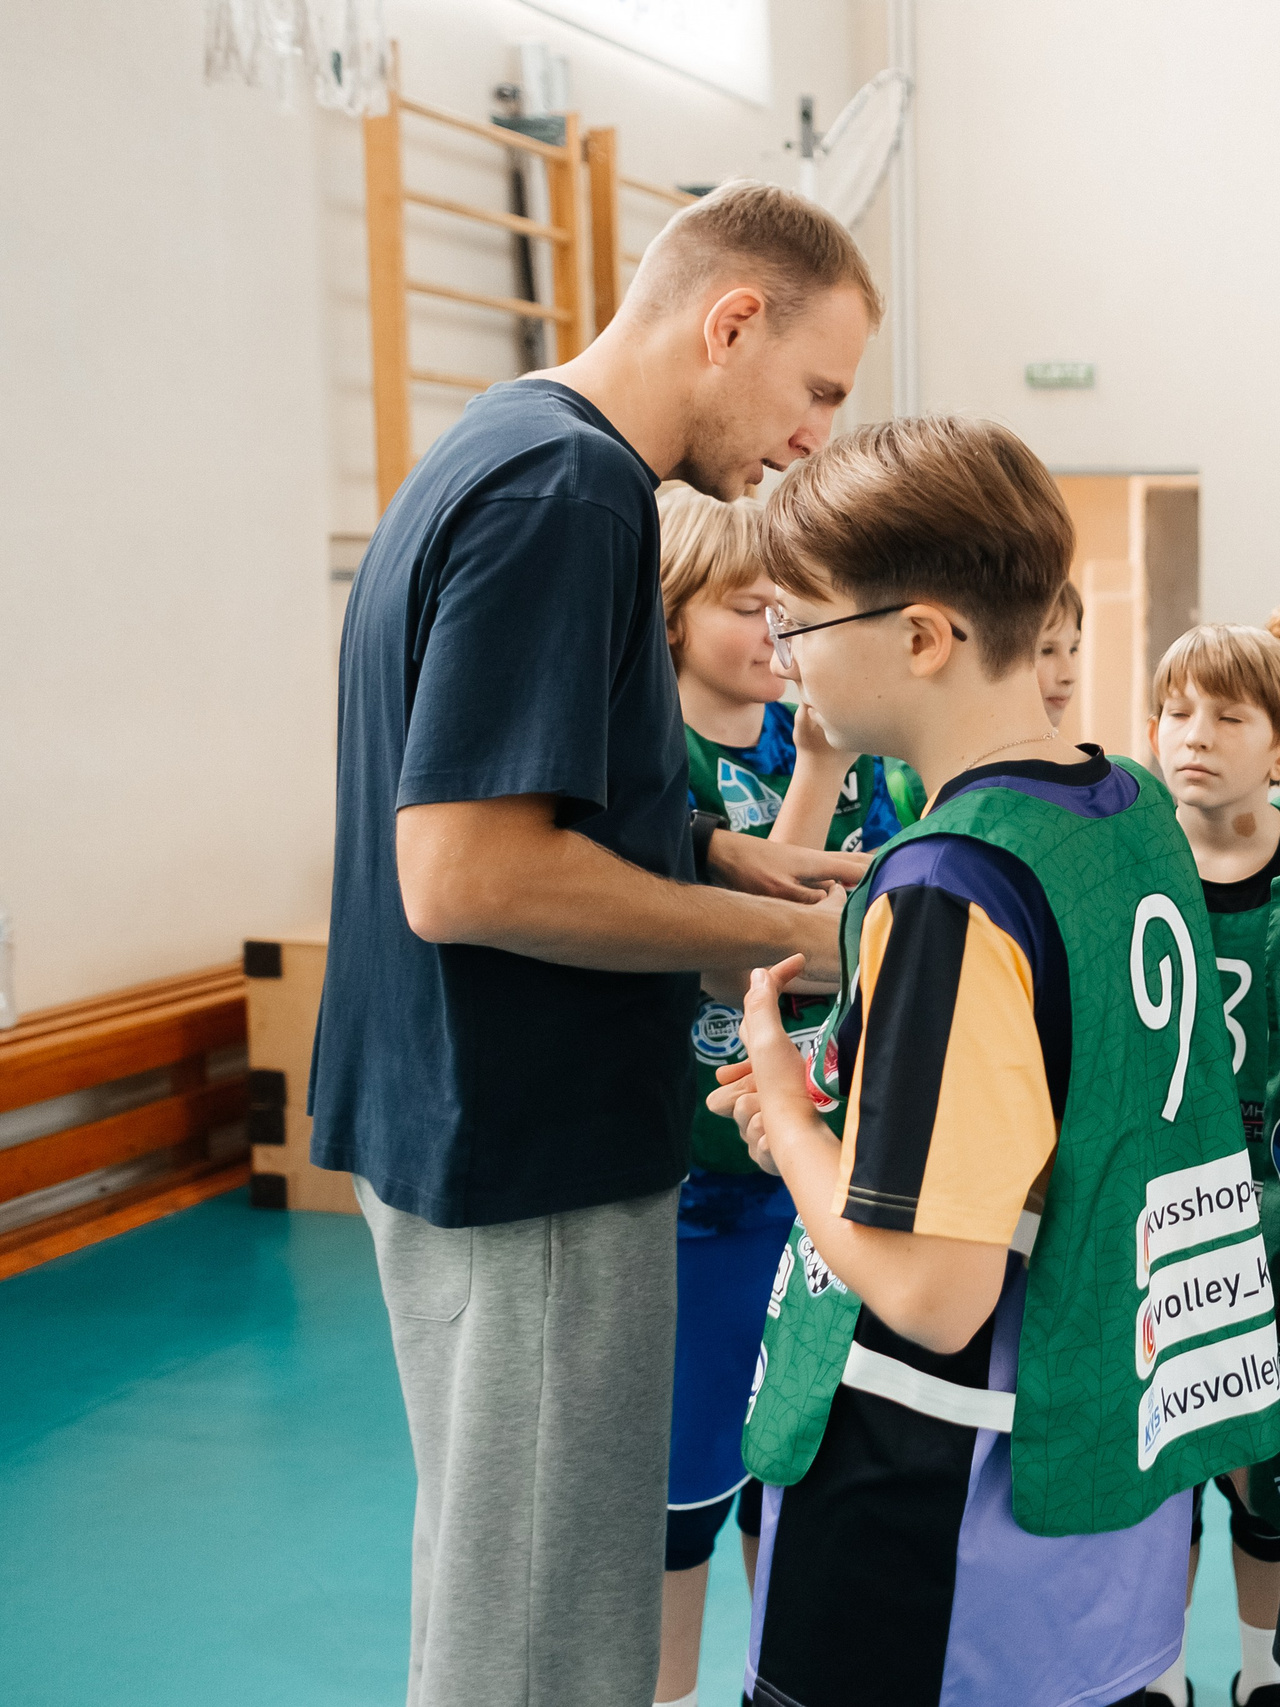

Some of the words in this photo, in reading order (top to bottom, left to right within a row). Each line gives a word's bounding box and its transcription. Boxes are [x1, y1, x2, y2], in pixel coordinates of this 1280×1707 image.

[1129, 893, 1198, 1123] 9
[1147, 1181, 1255, 1237] kvsshop
[1160, 1354, 1280, 1423] kvsvolley
